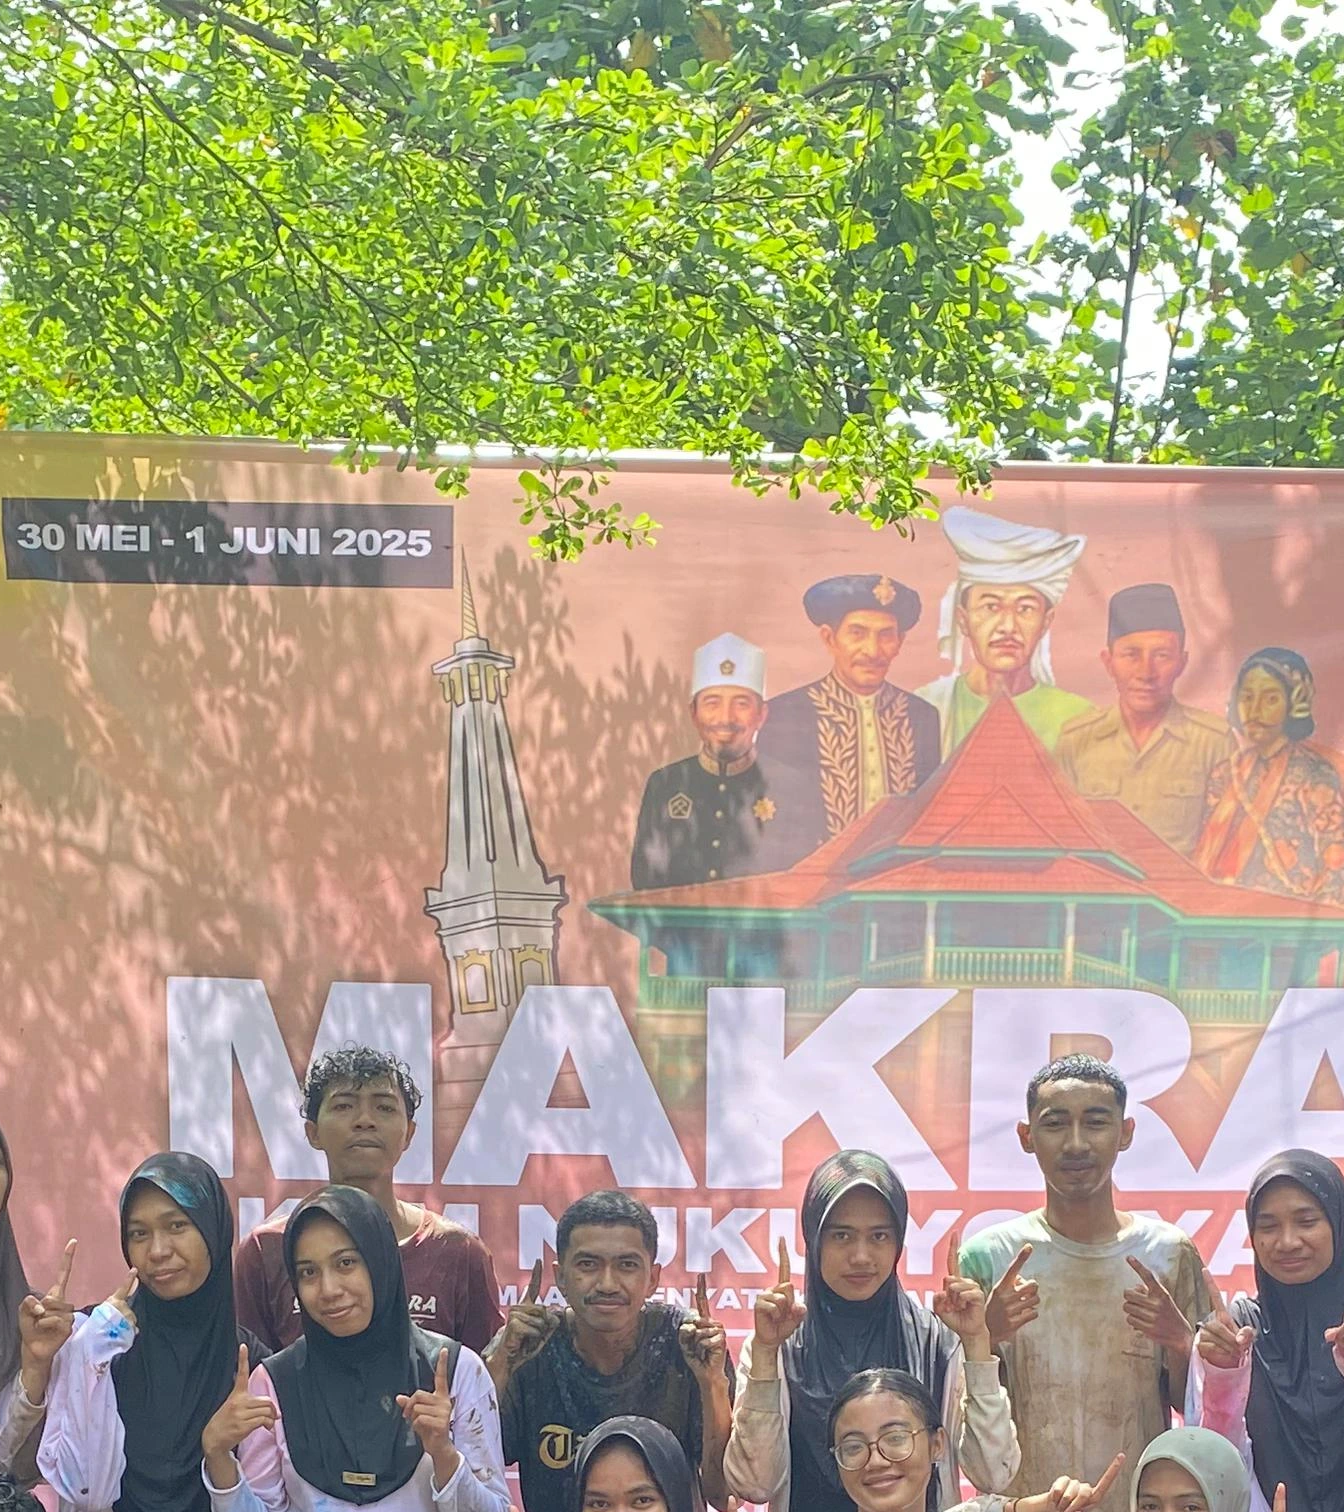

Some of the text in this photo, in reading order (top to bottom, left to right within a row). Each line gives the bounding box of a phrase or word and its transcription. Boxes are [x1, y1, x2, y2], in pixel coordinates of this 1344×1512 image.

[17, 523, 65, 552] 30
[76, 524, 150, 552] MEI
[185, 526, 205, 553] 1
[219, 527, 321, 556] JUNI
[332, 529, 432, 558] 2025
